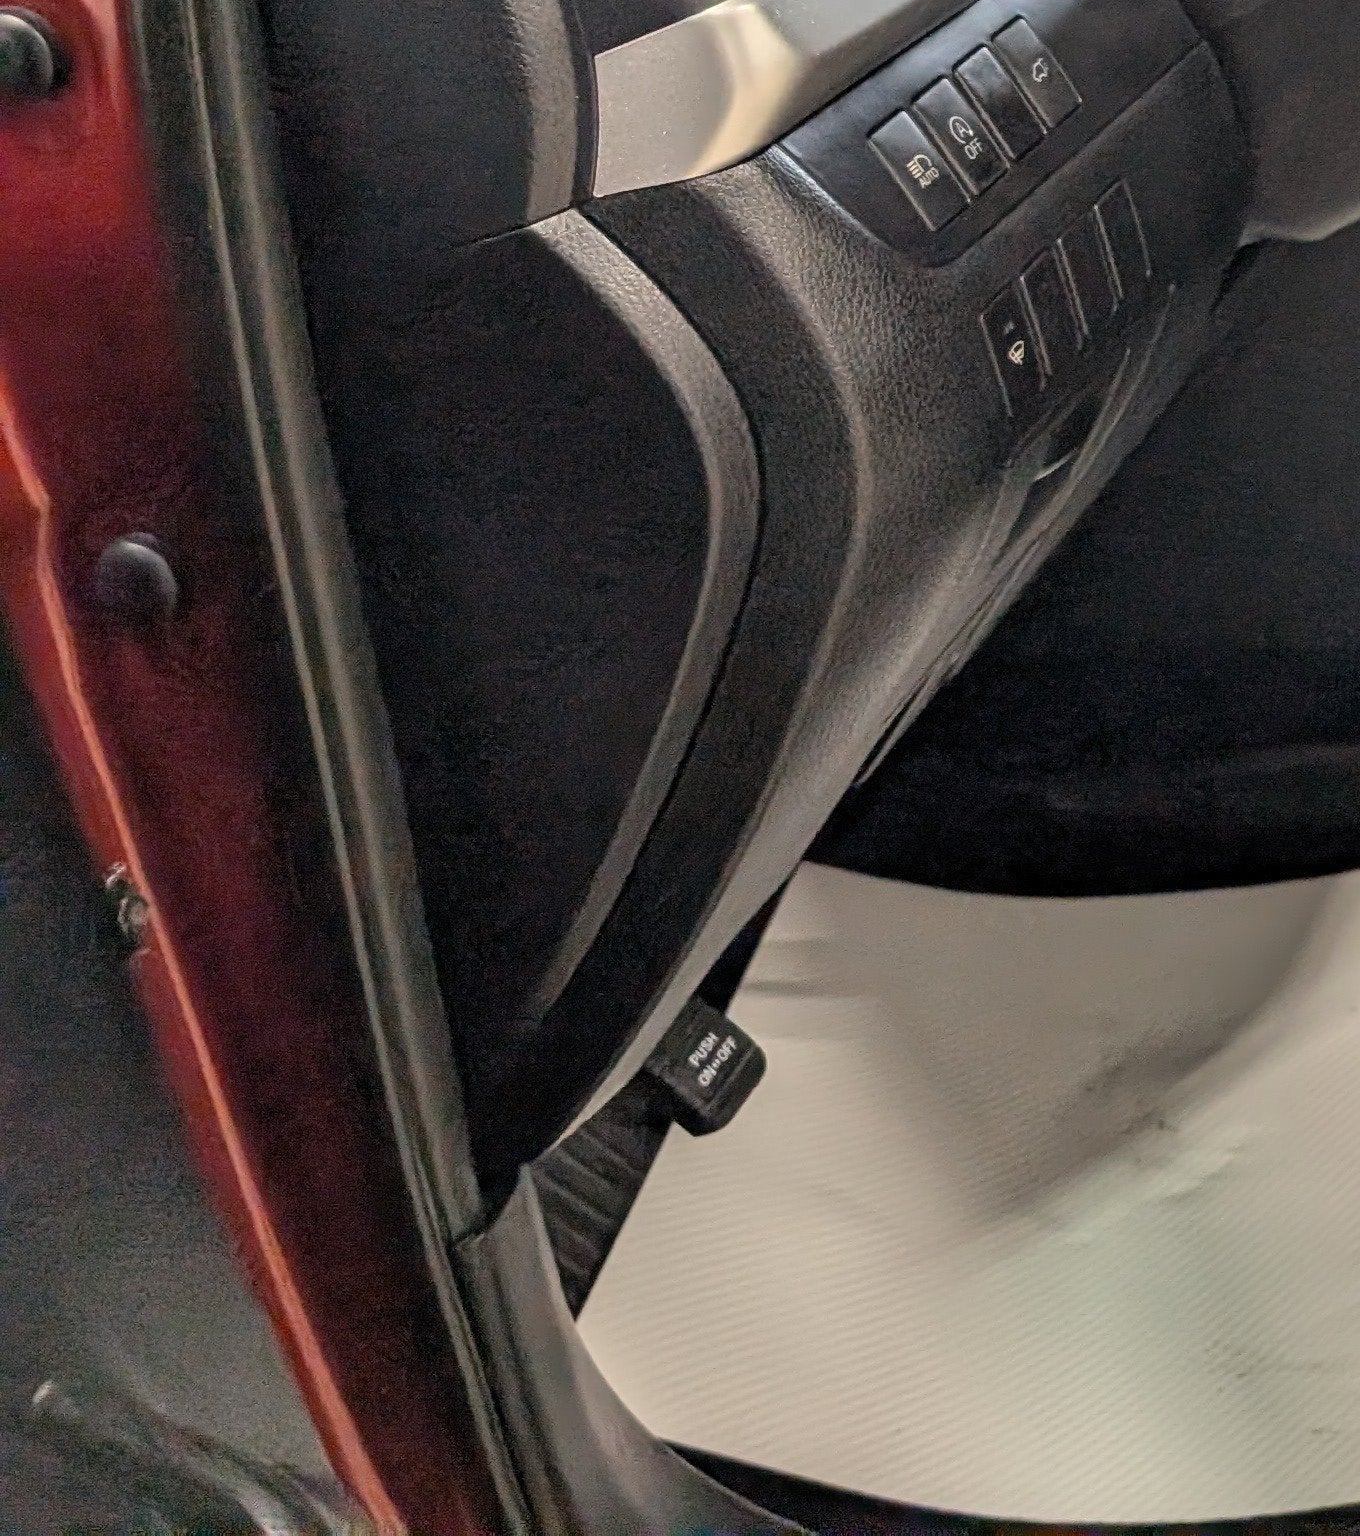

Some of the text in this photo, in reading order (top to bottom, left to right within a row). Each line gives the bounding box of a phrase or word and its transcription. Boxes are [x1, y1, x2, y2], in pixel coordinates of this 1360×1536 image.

[964, 138, 983, 160] OFF
[917, 167, 940, 188] AUTO
[688, 1032, 718, 1067] PUSH
